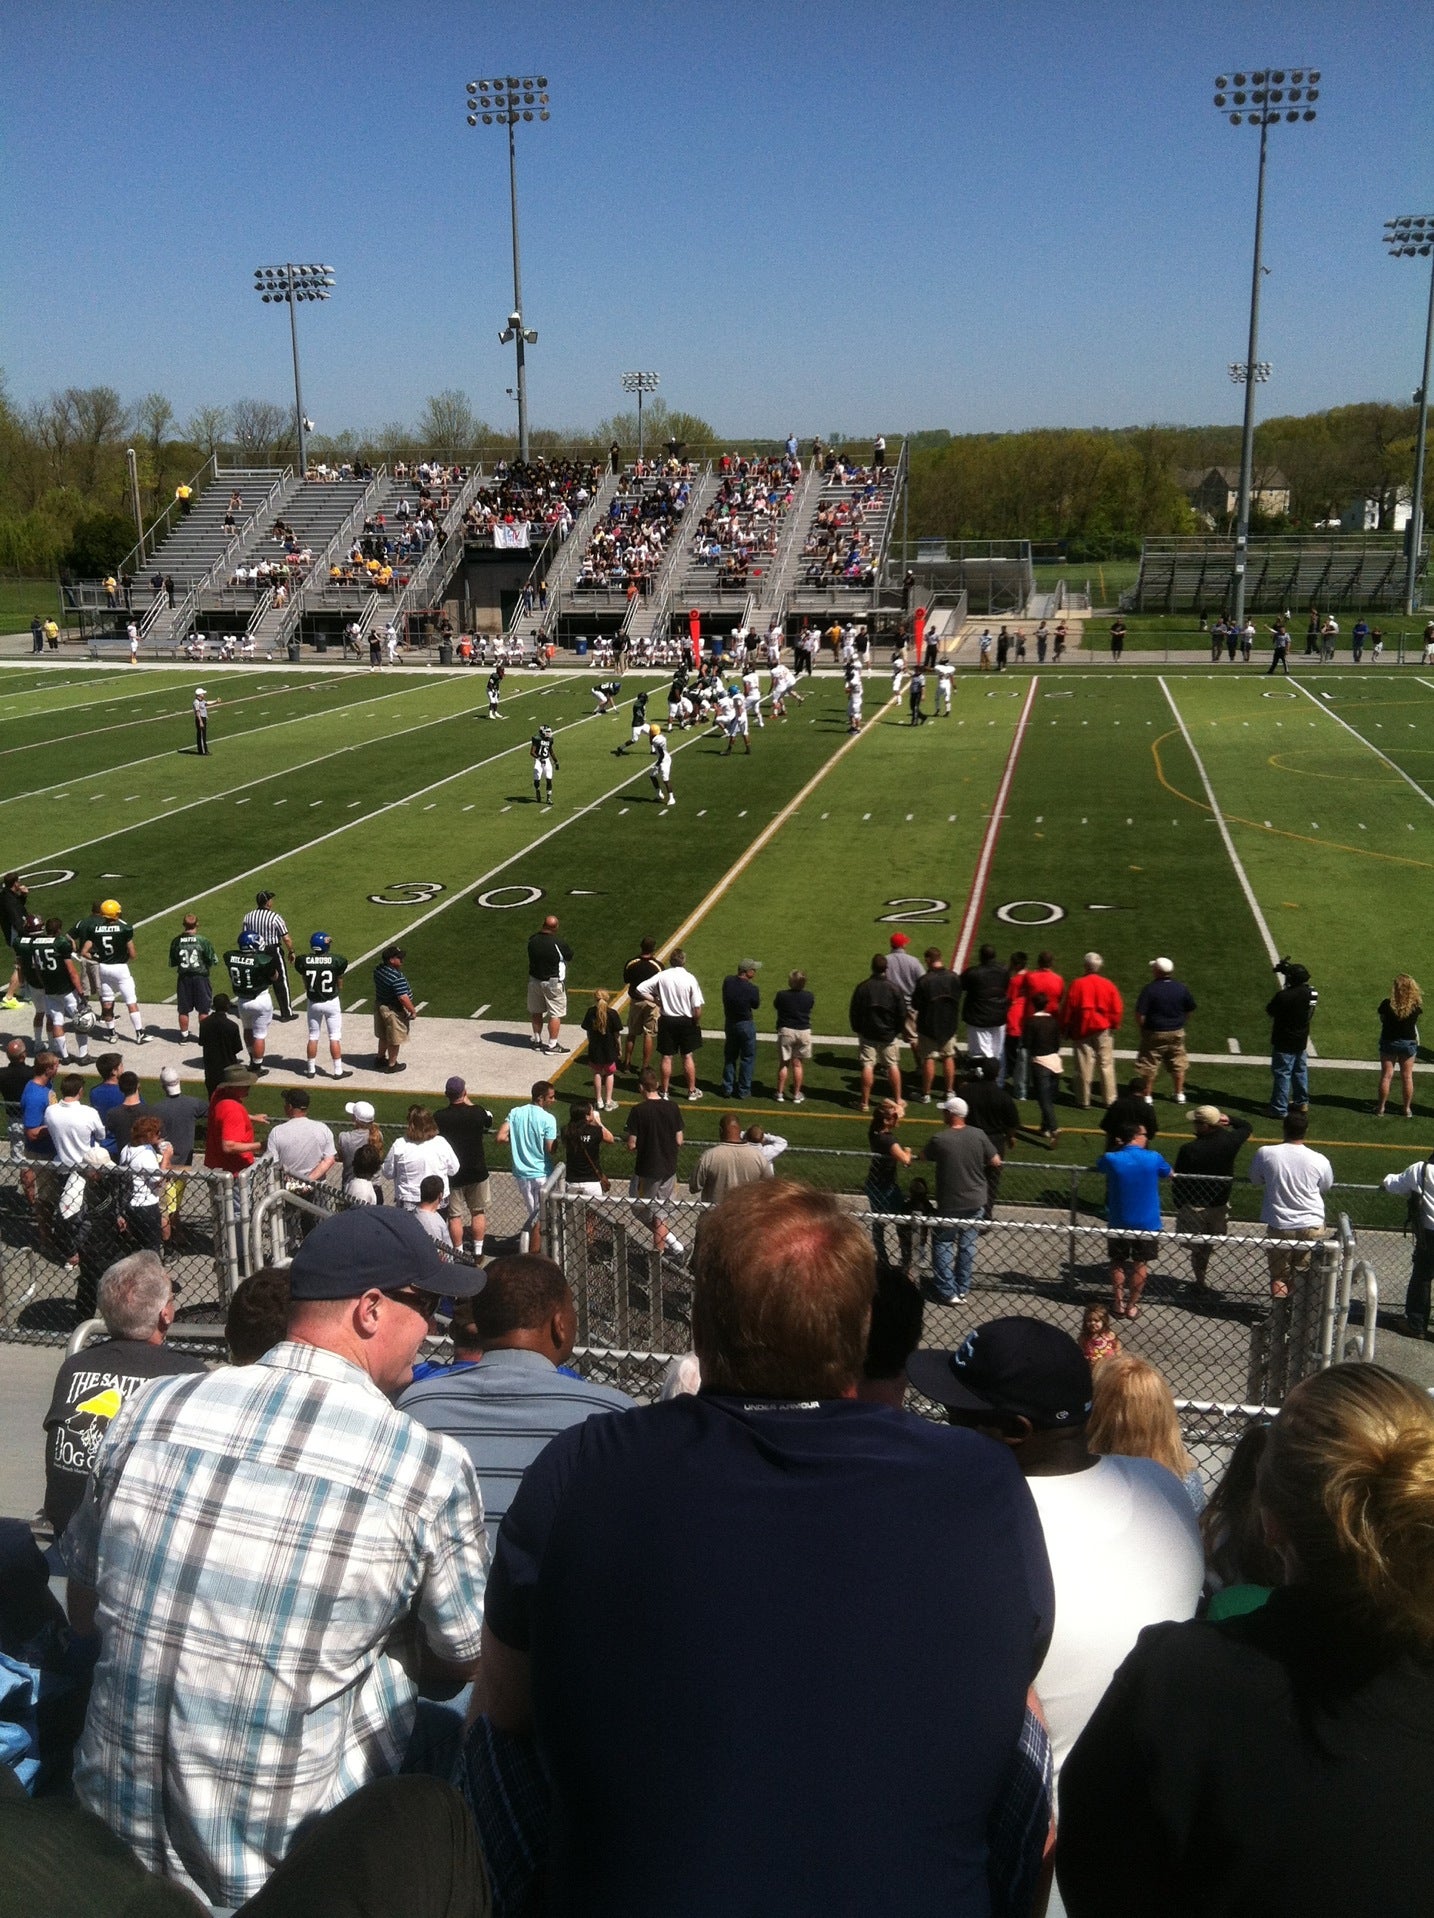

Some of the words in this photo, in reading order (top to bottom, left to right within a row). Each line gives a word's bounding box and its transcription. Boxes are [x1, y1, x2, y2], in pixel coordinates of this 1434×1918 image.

[102, 936, 115, 956] 5
[32, 949, 57, 970] 45
[179, 949, 200, 968] 34
[305, 956, 332, 965] CARUSO
[306, 970, 333, 993] 72
[66, 1371, 101, 1404] THE
[744, 1403, 777, 1411] UNDER
[779, 1401, 820, 1410] ARMOUR
[55, 1426, 84, 1467] DOG
